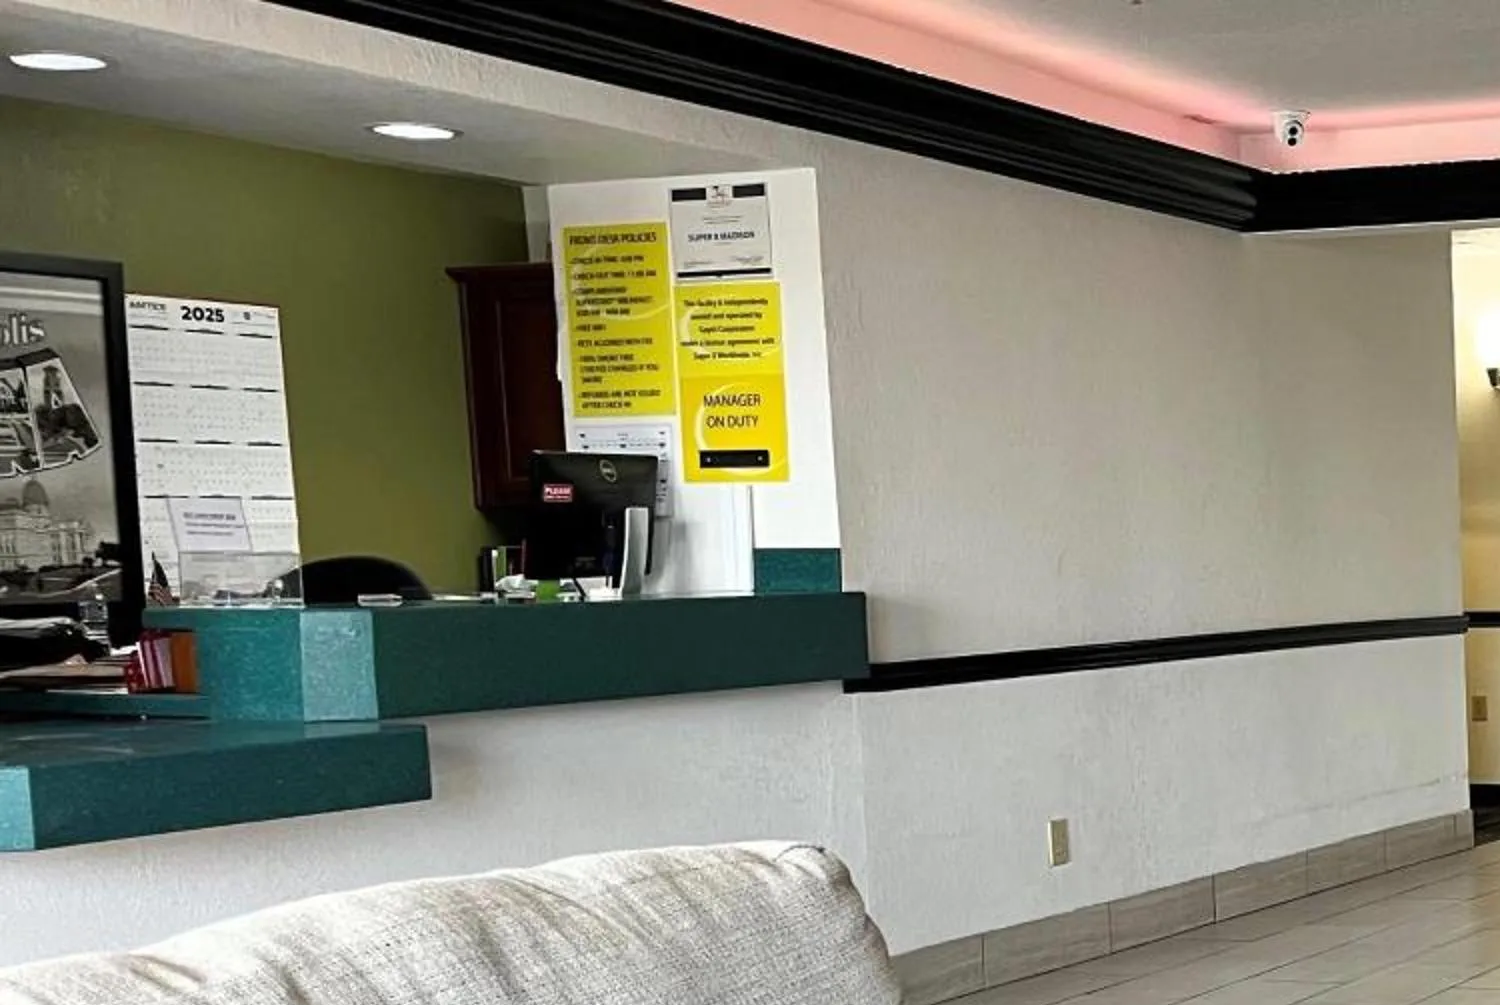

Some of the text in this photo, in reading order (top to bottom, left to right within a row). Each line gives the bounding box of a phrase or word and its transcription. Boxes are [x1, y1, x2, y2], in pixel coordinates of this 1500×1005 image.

[621, 231, 657, 244] POLICIES
[687, 233, 713, 242] SUPER
[179, 304, 225, 323] 2025
[703, 393, 761, 408] MANAGER
[706, 414, 759, 428] ON DUTY
[544, 487, 572, 495] PLEASE
